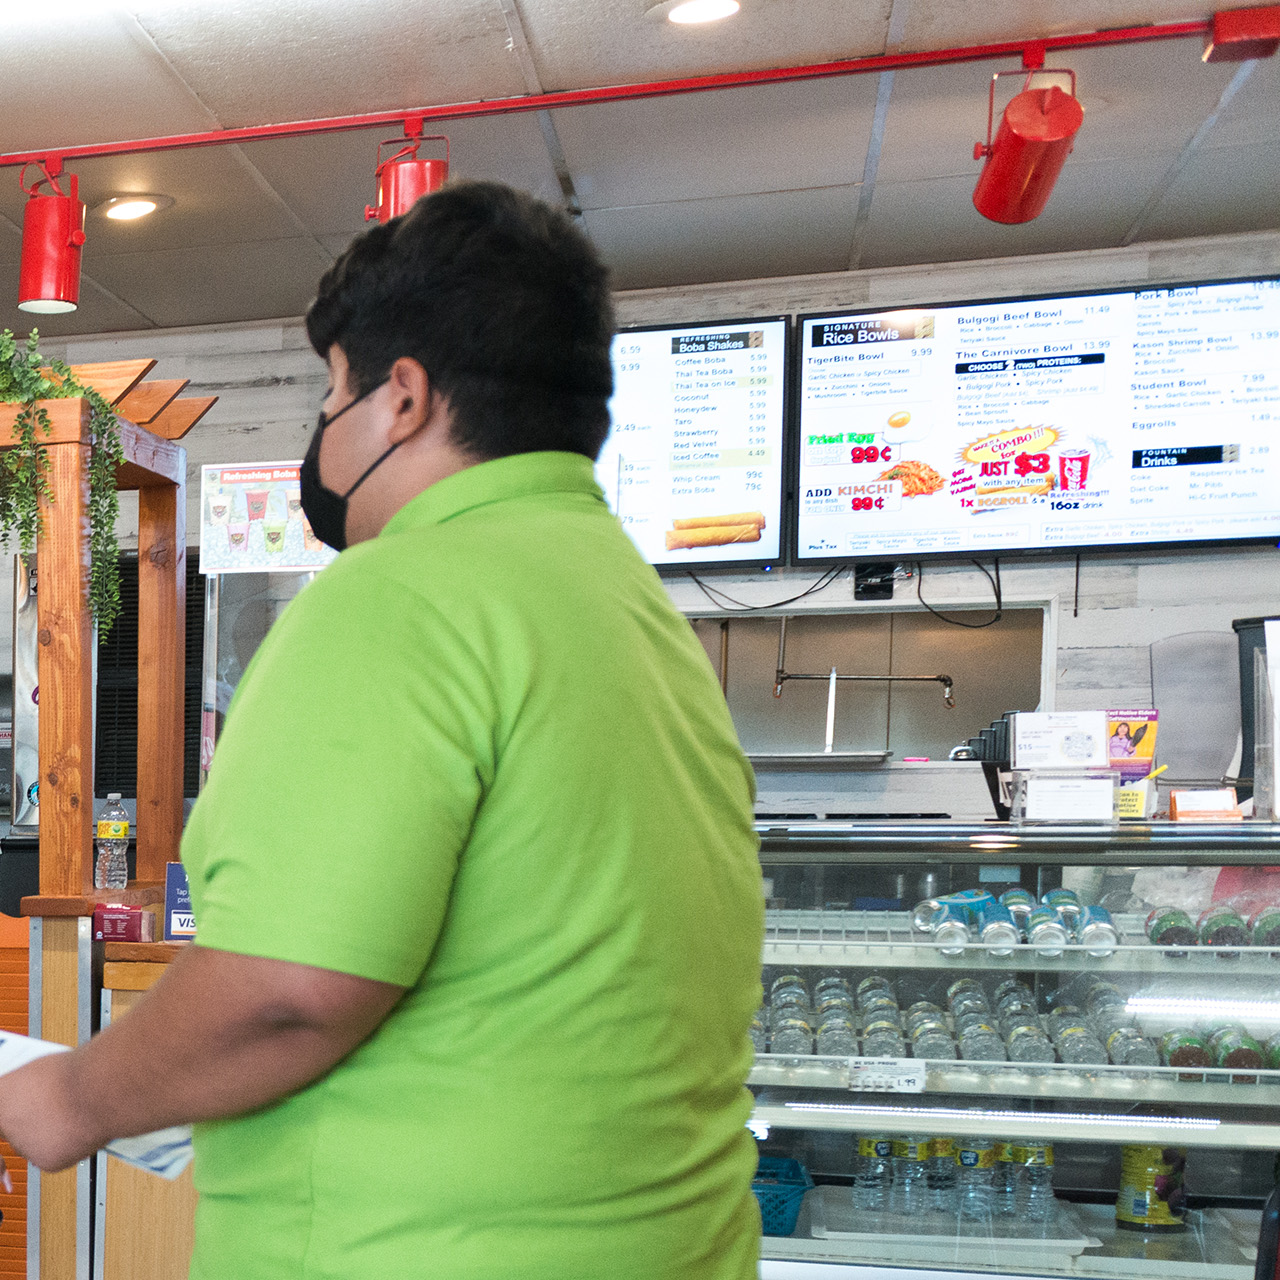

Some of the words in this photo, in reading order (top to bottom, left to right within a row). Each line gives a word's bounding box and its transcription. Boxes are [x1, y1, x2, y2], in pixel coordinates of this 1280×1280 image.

[1134, 291, 1162, 300] Pork
[1168, 287, 1199, 298] Bowl
[1084, 305, 1111, 314] 11.49
[957, 314, 999, 325] Bulgogi
[1003, 311, 1030, 321] Beef
[1034, 309, 1062, 318] Bowl
[824, 321, 881, 332] SIGNATURE
[680, 333, 731, 343] REFRESHING
[822, 332, 854, 345] Rice
[858, 328, 900, 342] Bowls
[679, 342, 705, 353] Boba
[706, 340, 745, 350] Shakes
[1083, 340, 1111, 350] 13.99
[1132, 340, 1165, 349] Kason
[1168, 338, 1204, 348] Shrimp
[1206, 336, 1233, 344] Bowl
[910, 348, 933, 356] 9.99
[956, 350, 978, 360] The
[982, 346, 1040, 358] Carnivore
[1043, 344, 1073, 353] Bowl
[675, 358, 702, 366] Coffee
[704, 356, 726, 364] Boba
[808, 355, 854, 366] TigerBite
[858, 352, 884, 360] Bowl
[968, 362, 1004, 372] CHOOSE
[1005, 360, 1016, 371] 2
[1036, 357, 1082, 368] PROTEINS:
[675, 370, 693, 378] Thai
[696, 369, 710, 377] Tea
[711, 368, 734, 376] Boba
[675, 382, 693, 390] Thai
[1130, 382, 1175, 392] Student
[1178, 379, 1207, 388] Bowl
[674, 394, 710, 402] Coconut
[749, 390, 767, 398] 5.99
[674, 404, 718, 414] Honeydew
[749, 402, 766, 410] 5.99
[674, 418, 692, 426] Taro
[748, 414, 766, 422] 5.99
[616, 424, 636, 433] 2.49
[748, 425, 766, 433] 5.99
[1132, 420, 1177, 430] Eggrolls
[674, 428, 719, 438] Strawberry
[748, 437, 766, 445] 5.99
[846, 432, 876, 446] Egg
[673, 441, 690, 450] Red
[692, 440, 718, 448] Velvet
[673, 453, 690, 462] Iced
[692, 452, 720, 460] Coffee
[1000, 450, 1016, 460] for
[1142, 448, 1188, 456] FOUNTAIN
[979, 460, 1010, 478] JUST
[1014, 451, 1051, 478] $3
[1140, 456, 1178, 468] Drinks
[223, 470, 272, 481] Refreshing
[273, 470, 297, 479] Boba
[672, 474, 693, 484] Whip
[694, 474, 721, 482] Cream
[982, 478, 1003, 487] with
[1005, 478, 1022, 488] any
[1024, 476, 1045, 486] item
[672, 487, 692, 496] Extra
[694, 486, 716, 494] Boba
[806, 488, 832, 498] ADD
[838, 484, 893, 496] KIMCHI
[852, 496, 885, 512] 99¢
[960, 498, 974, 508] 1x
[978, 496, 1029, 508] EGGROLL
[1050, 501, 1080, 511] 16oz
[1082, 502, 1104, 510] drink
[176, 888, 188, 896] Tap
[178, 918, 197, 928] VIS
